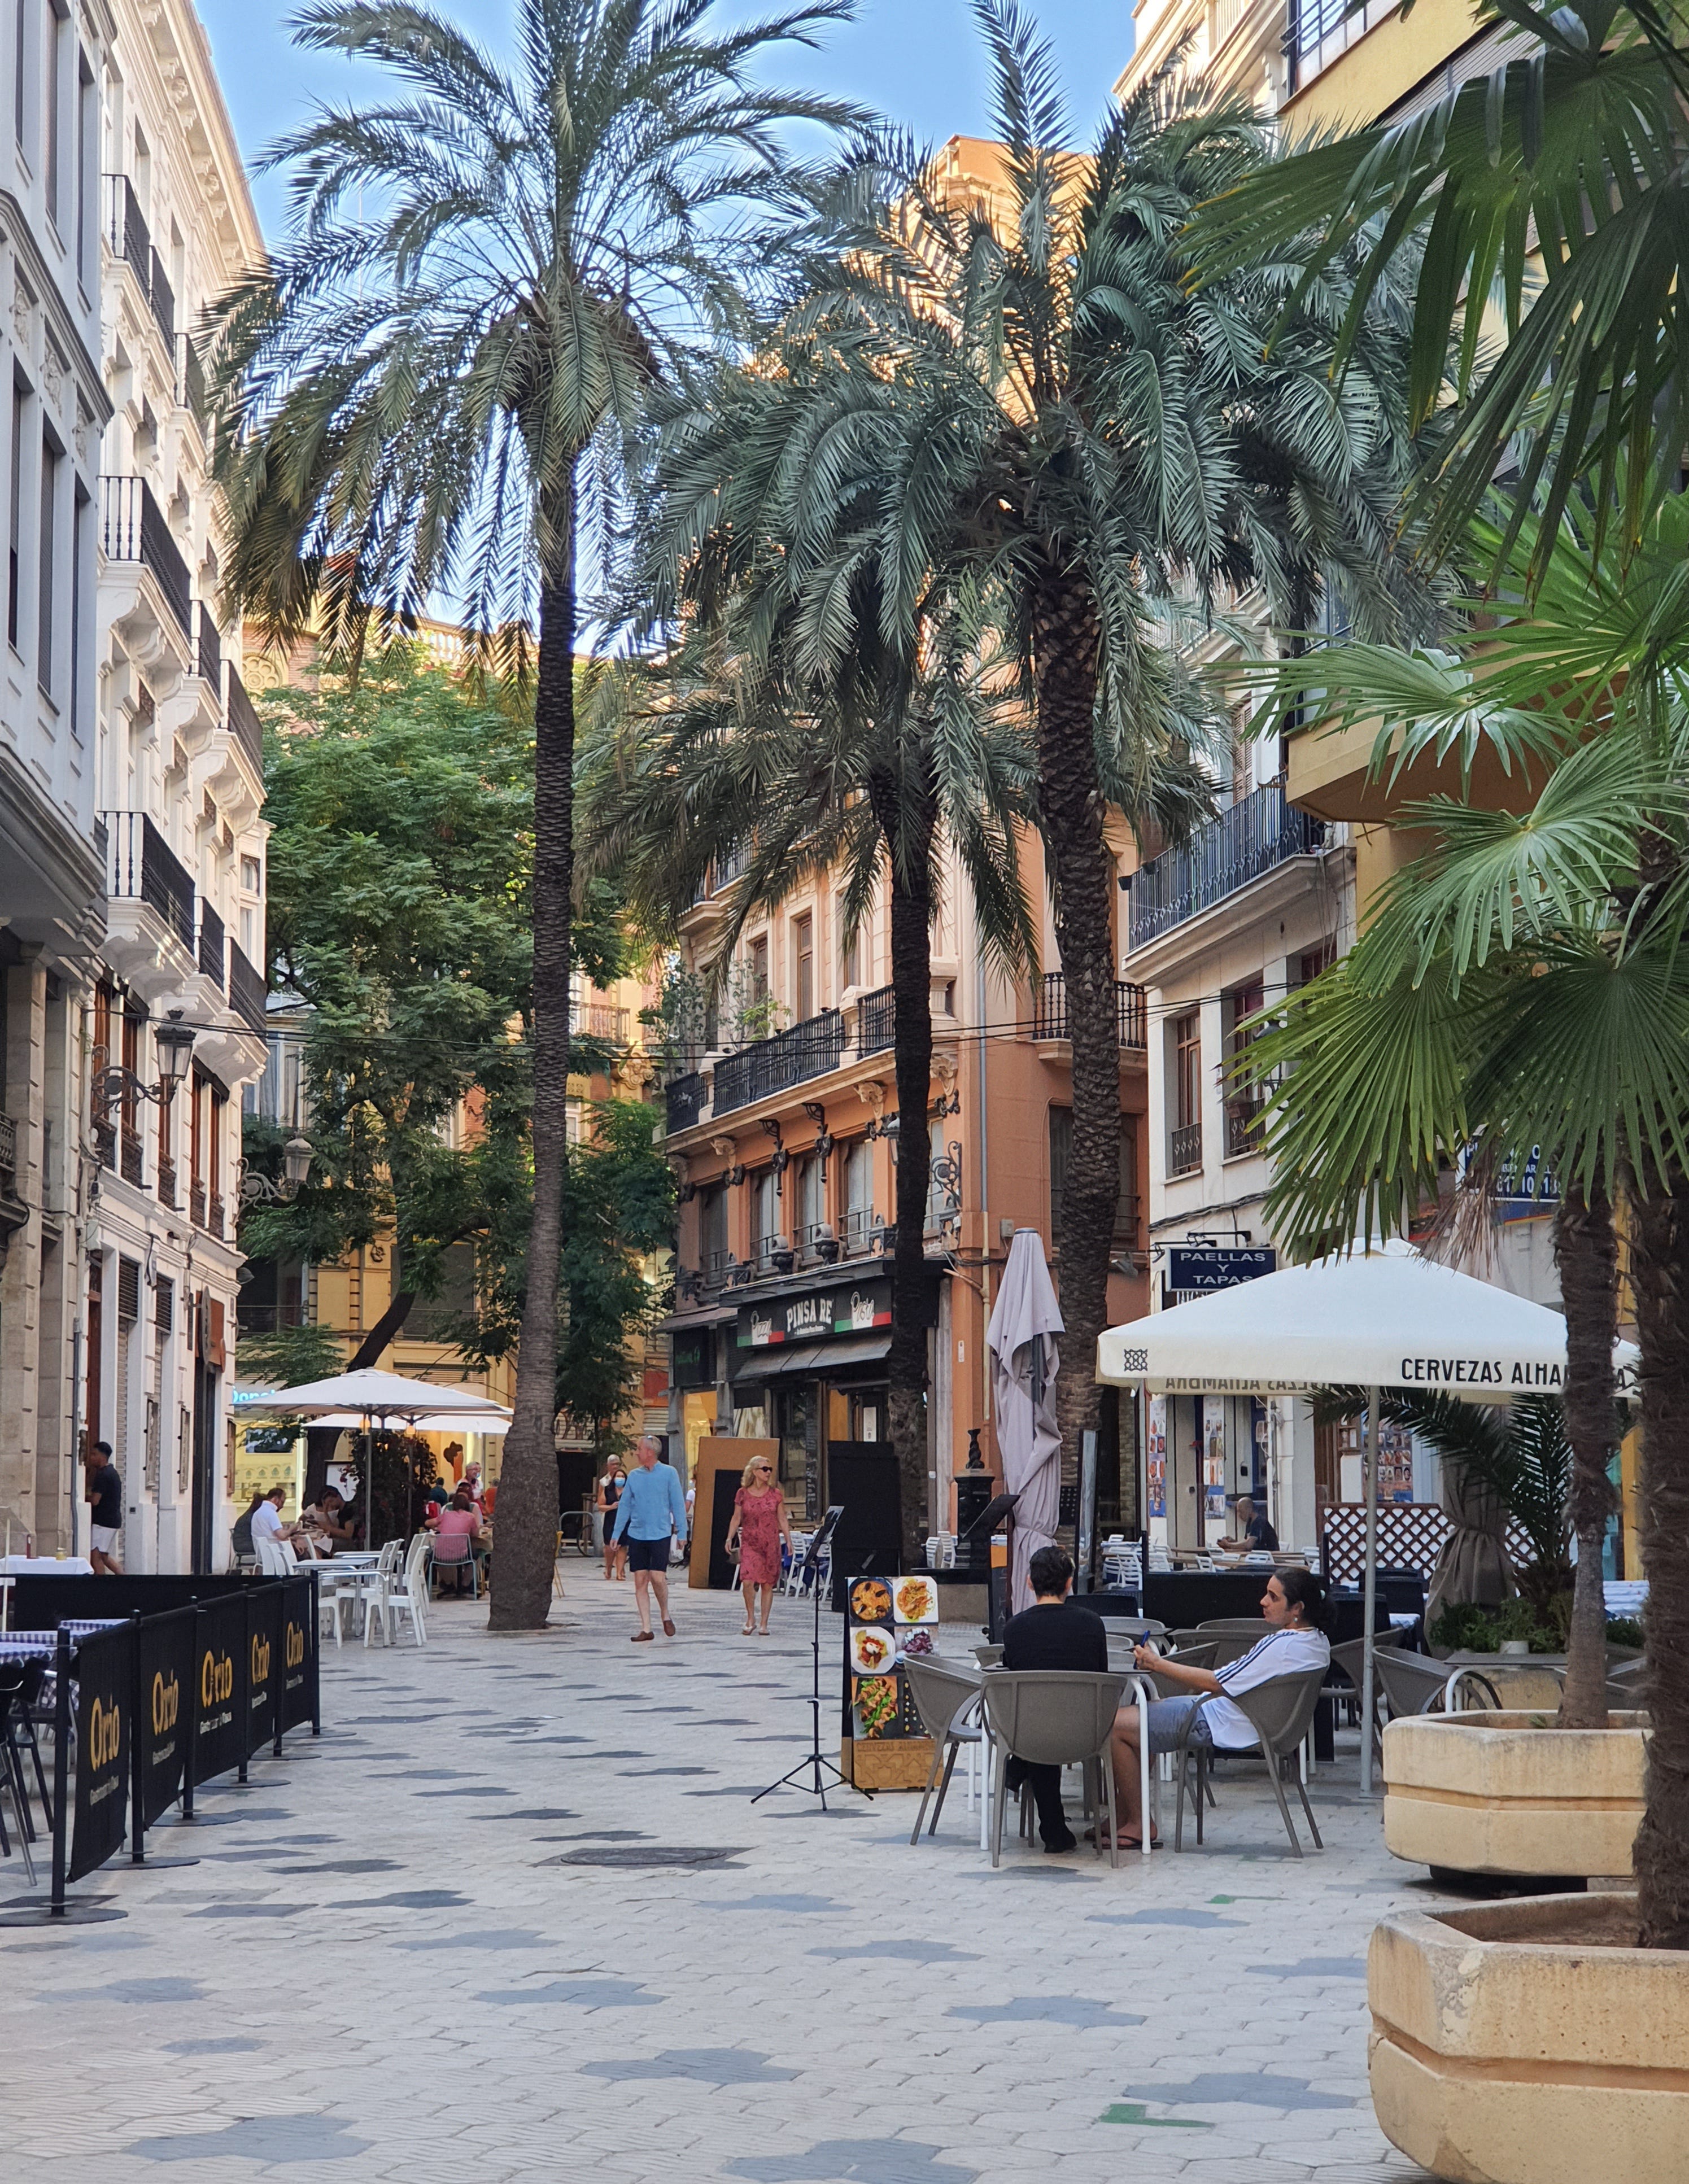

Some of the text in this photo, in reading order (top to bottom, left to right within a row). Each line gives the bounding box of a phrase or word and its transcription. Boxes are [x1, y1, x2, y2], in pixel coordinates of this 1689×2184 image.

[1180, 1252, 1266, 1261] PAELLAS
[1217, 1264, 1229, 1273] Y
[1193, 1275, 1253, 1284] TAPAS
[787, 1299, 817, 1333] PINSA
[1402, 1358, 1502, 1383] CERVEZAS
[252, 1632, 270, 1685] Orio
[287, 1621, 304, 1668] Orio
[202, 1648, 233, 1709] Orio
[152, 1668, 178, 1736] Orio
[90, 1694, 120, 1772] Orio
